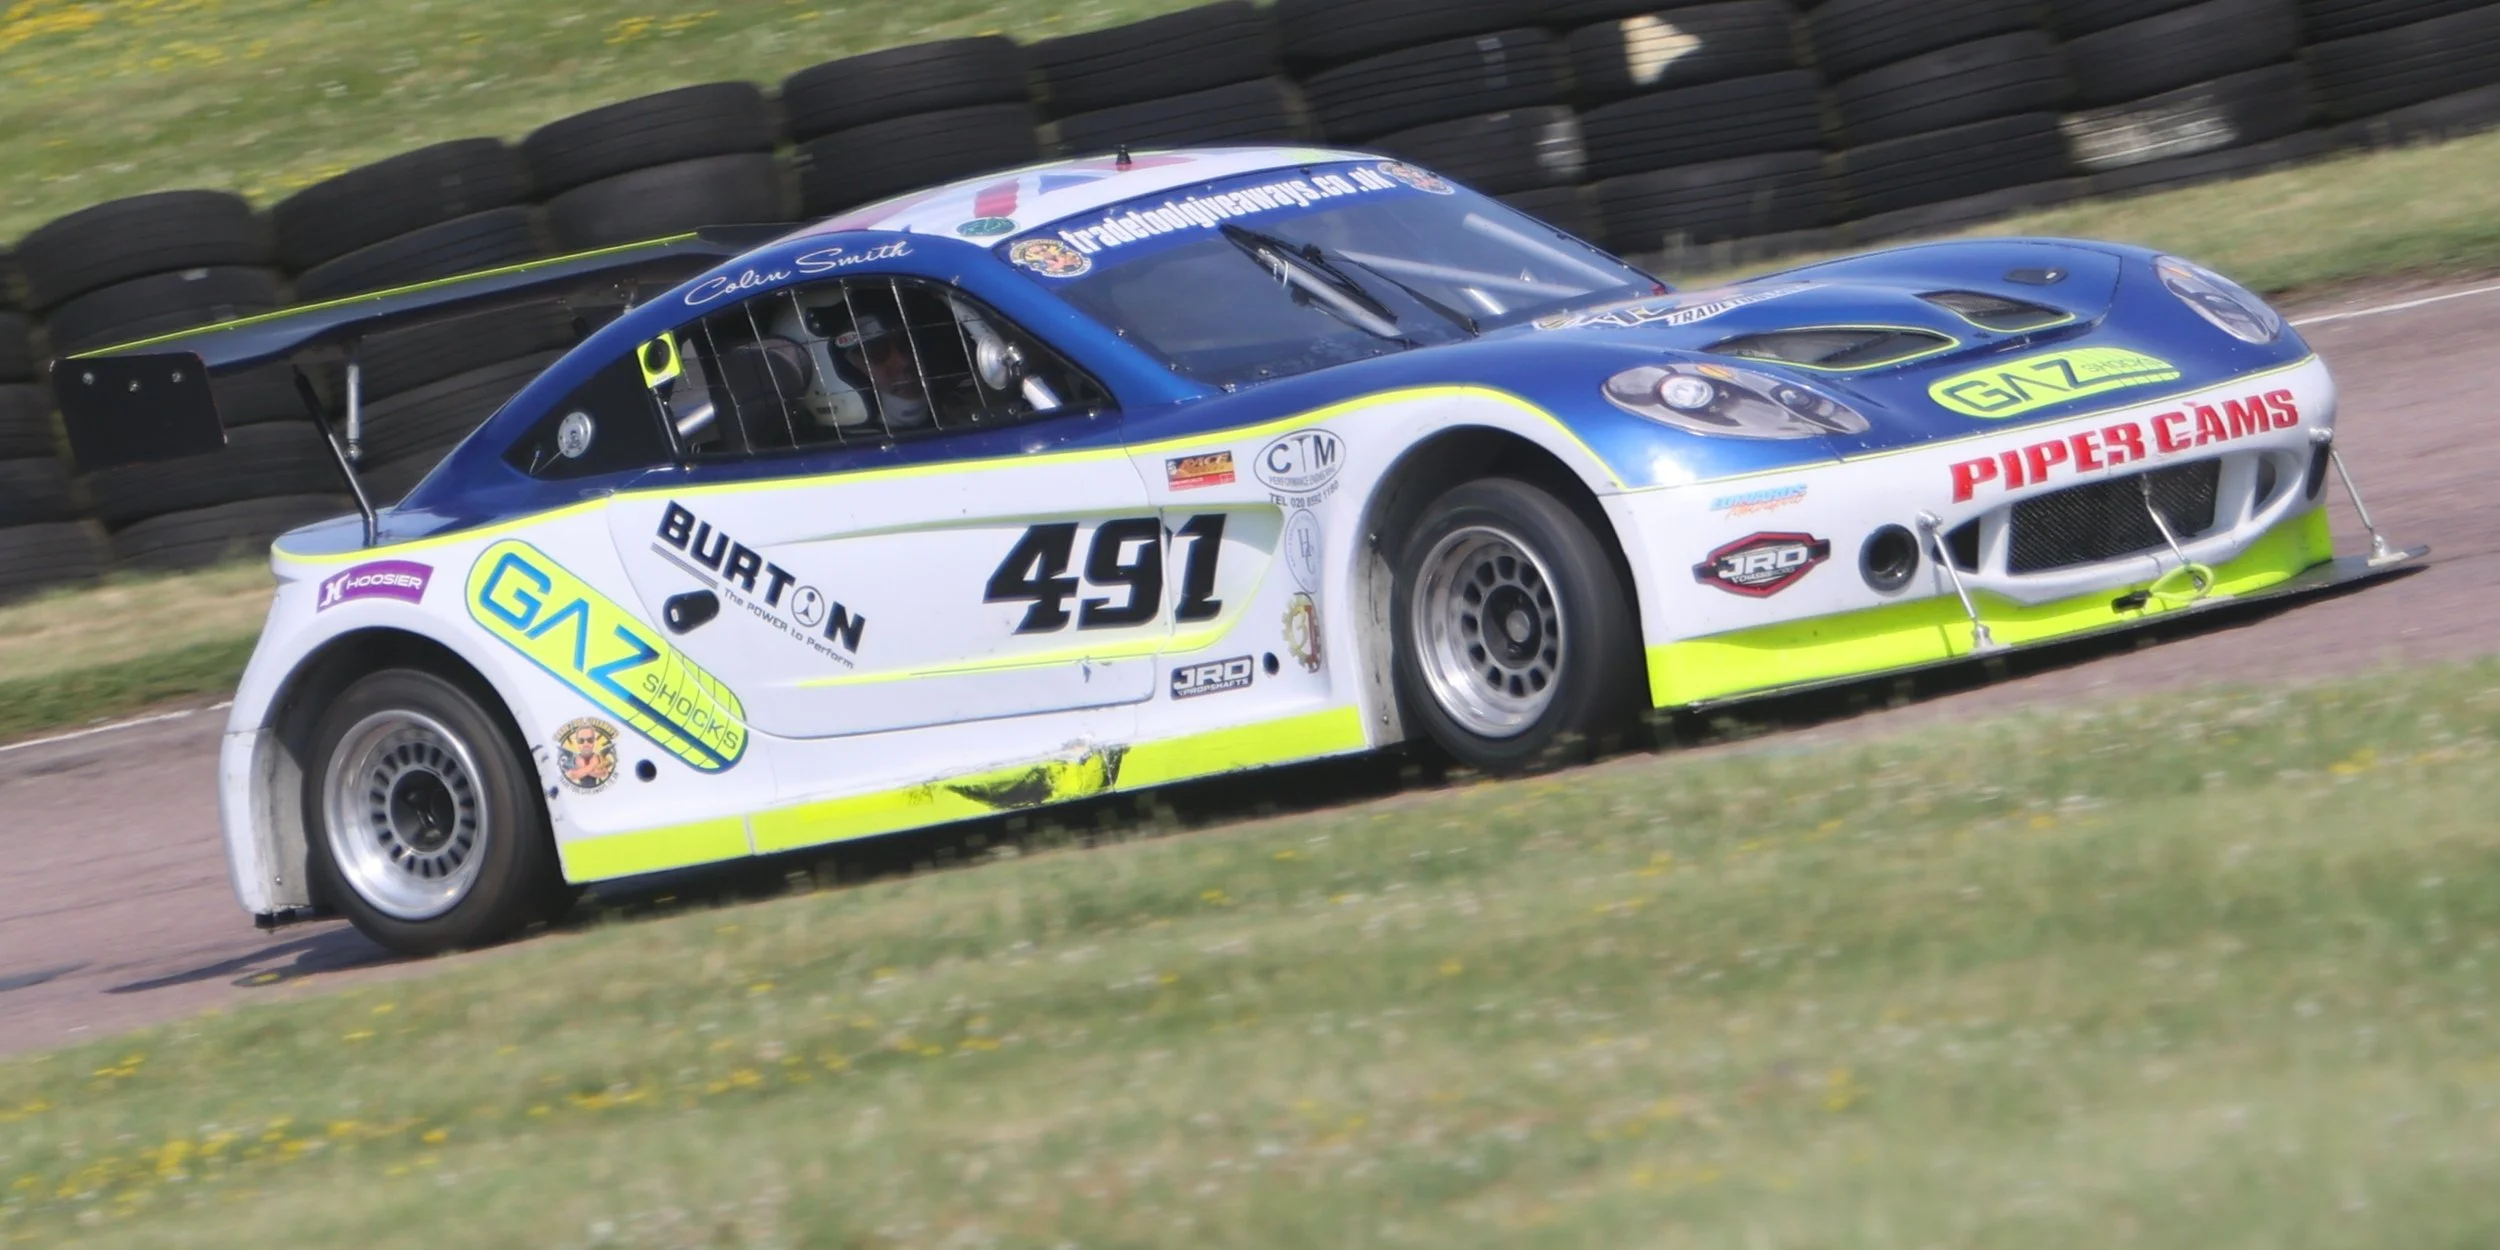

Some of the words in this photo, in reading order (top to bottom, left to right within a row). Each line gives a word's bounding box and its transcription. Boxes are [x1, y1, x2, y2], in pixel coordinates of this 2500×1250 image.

[684, 270, 792, 305] Colin
[795, 241, 914, 273] Smith
[1943, 358, 2086, 412] GAZ
[1267, 434, 1336, 474] CTM
[1948, 422, 2146, 504] PIPER
[2150, 388, 2300, 455] CAMS
[1269, 492, 1288, 507] TEL
[346, 573, 423, 591] HOOSIER
[656, 499, 866, 655] BURTON
[982, 513, 1227, 636] 491
[1718, 543, 1809, 579] JRD
[479, 552, 660, 704] GAZ
[642, 673, 739, 750] SHOCKS
[724, 588, 744, 607] The
[747, 600, 788, 632] POWER
[791, 627, 803, 641] to
[806, 636, 854, 669] Perform
[1173, 659, 1251, 690] JRD
